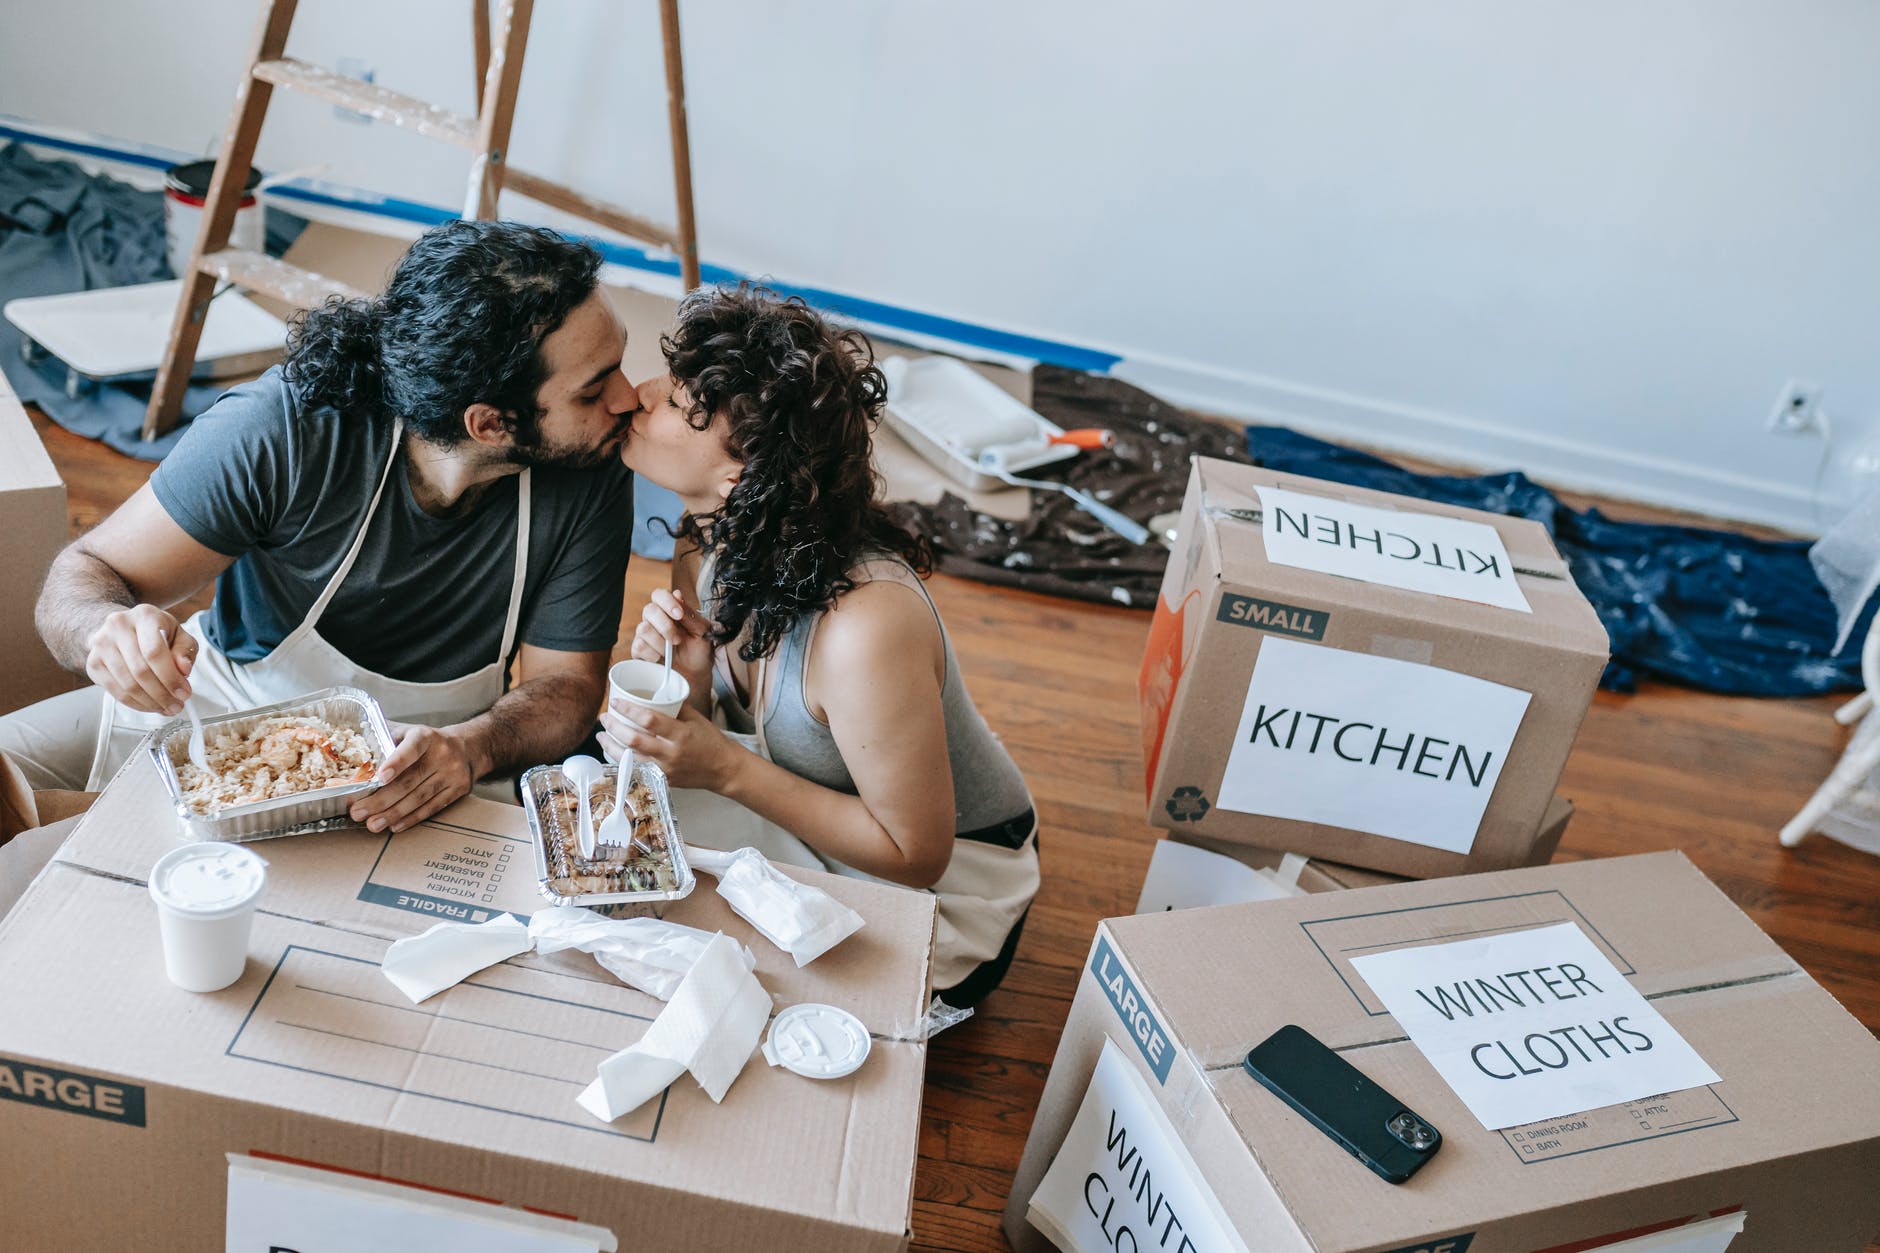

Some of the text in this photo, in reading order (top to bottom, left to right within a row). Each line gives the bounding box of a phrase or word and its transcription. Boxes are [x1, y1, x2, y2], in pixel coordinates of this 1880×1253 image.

[1274, 506, 1502, 578] KITCHEN
[1229, 599, 1315, 635] SMALL
[1249, 704, 1493, 788] KITCHEN
[442, 852, 489, 868] GARAGE
[463, 846, 494, 858] ATTIC
[424, 859, 484, 878] BASEMENT
[427, 872, 480, 888] LAUNDRY
[427, 883, 476, 899] KITCHEN
[397, 895, 468, 919] FRAGILE
[1415, 962, 1604, 1022] WINTER
[1100, 952, 1166, 1066] LARGE
[1470, 1015, 1653, 1081] CLOTHS
[1644, 1104, 1669, 1118] ATTIC
[1527, 1124, 1560, 1140] DINING
[1560, 1120, 1589, 1134] ROOM
[1536, 1139, 1562, 1152] BATH
